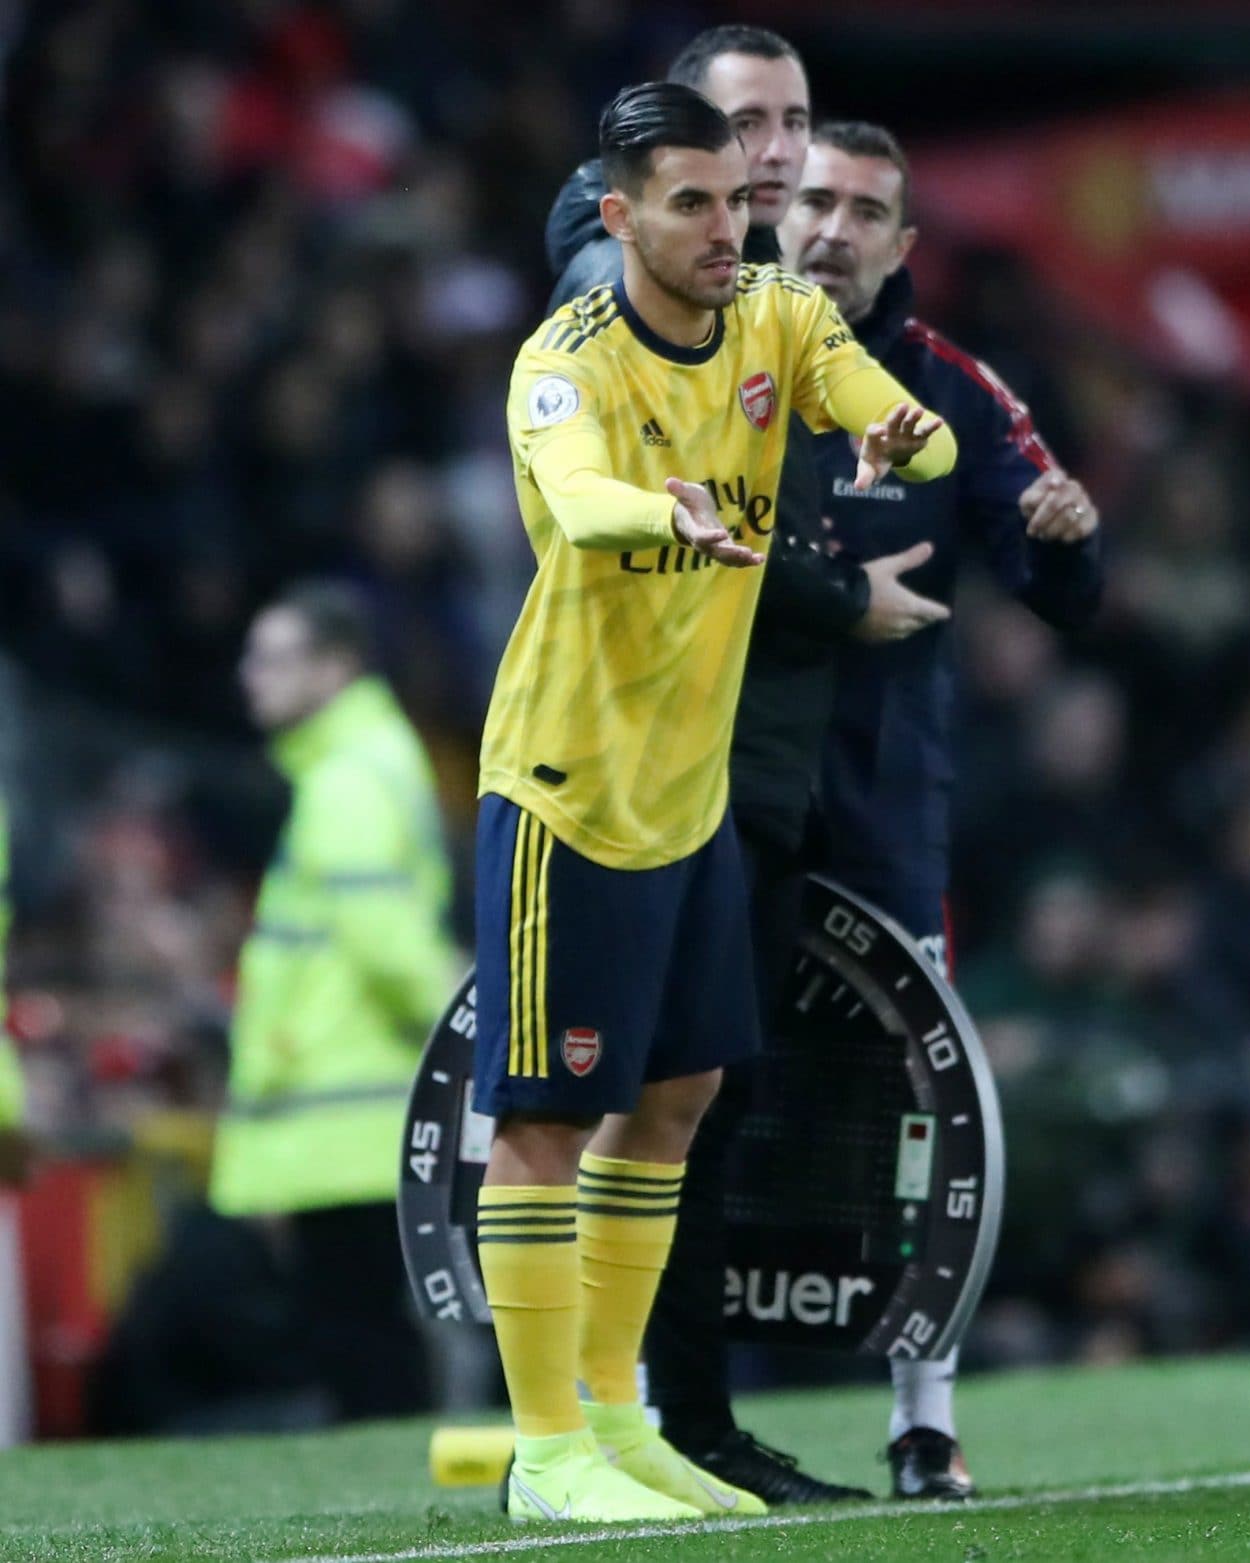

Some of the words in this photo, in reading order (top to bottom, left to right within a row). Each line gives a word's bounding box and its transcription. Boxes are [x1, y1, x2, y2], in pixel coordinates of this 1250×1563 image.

[823, 904, 878, 957] 05
[921, 1020, 958, 1073] 10
[410, 1120, 441, 1184] 45
[946, 1175, 977, 1219] 15
